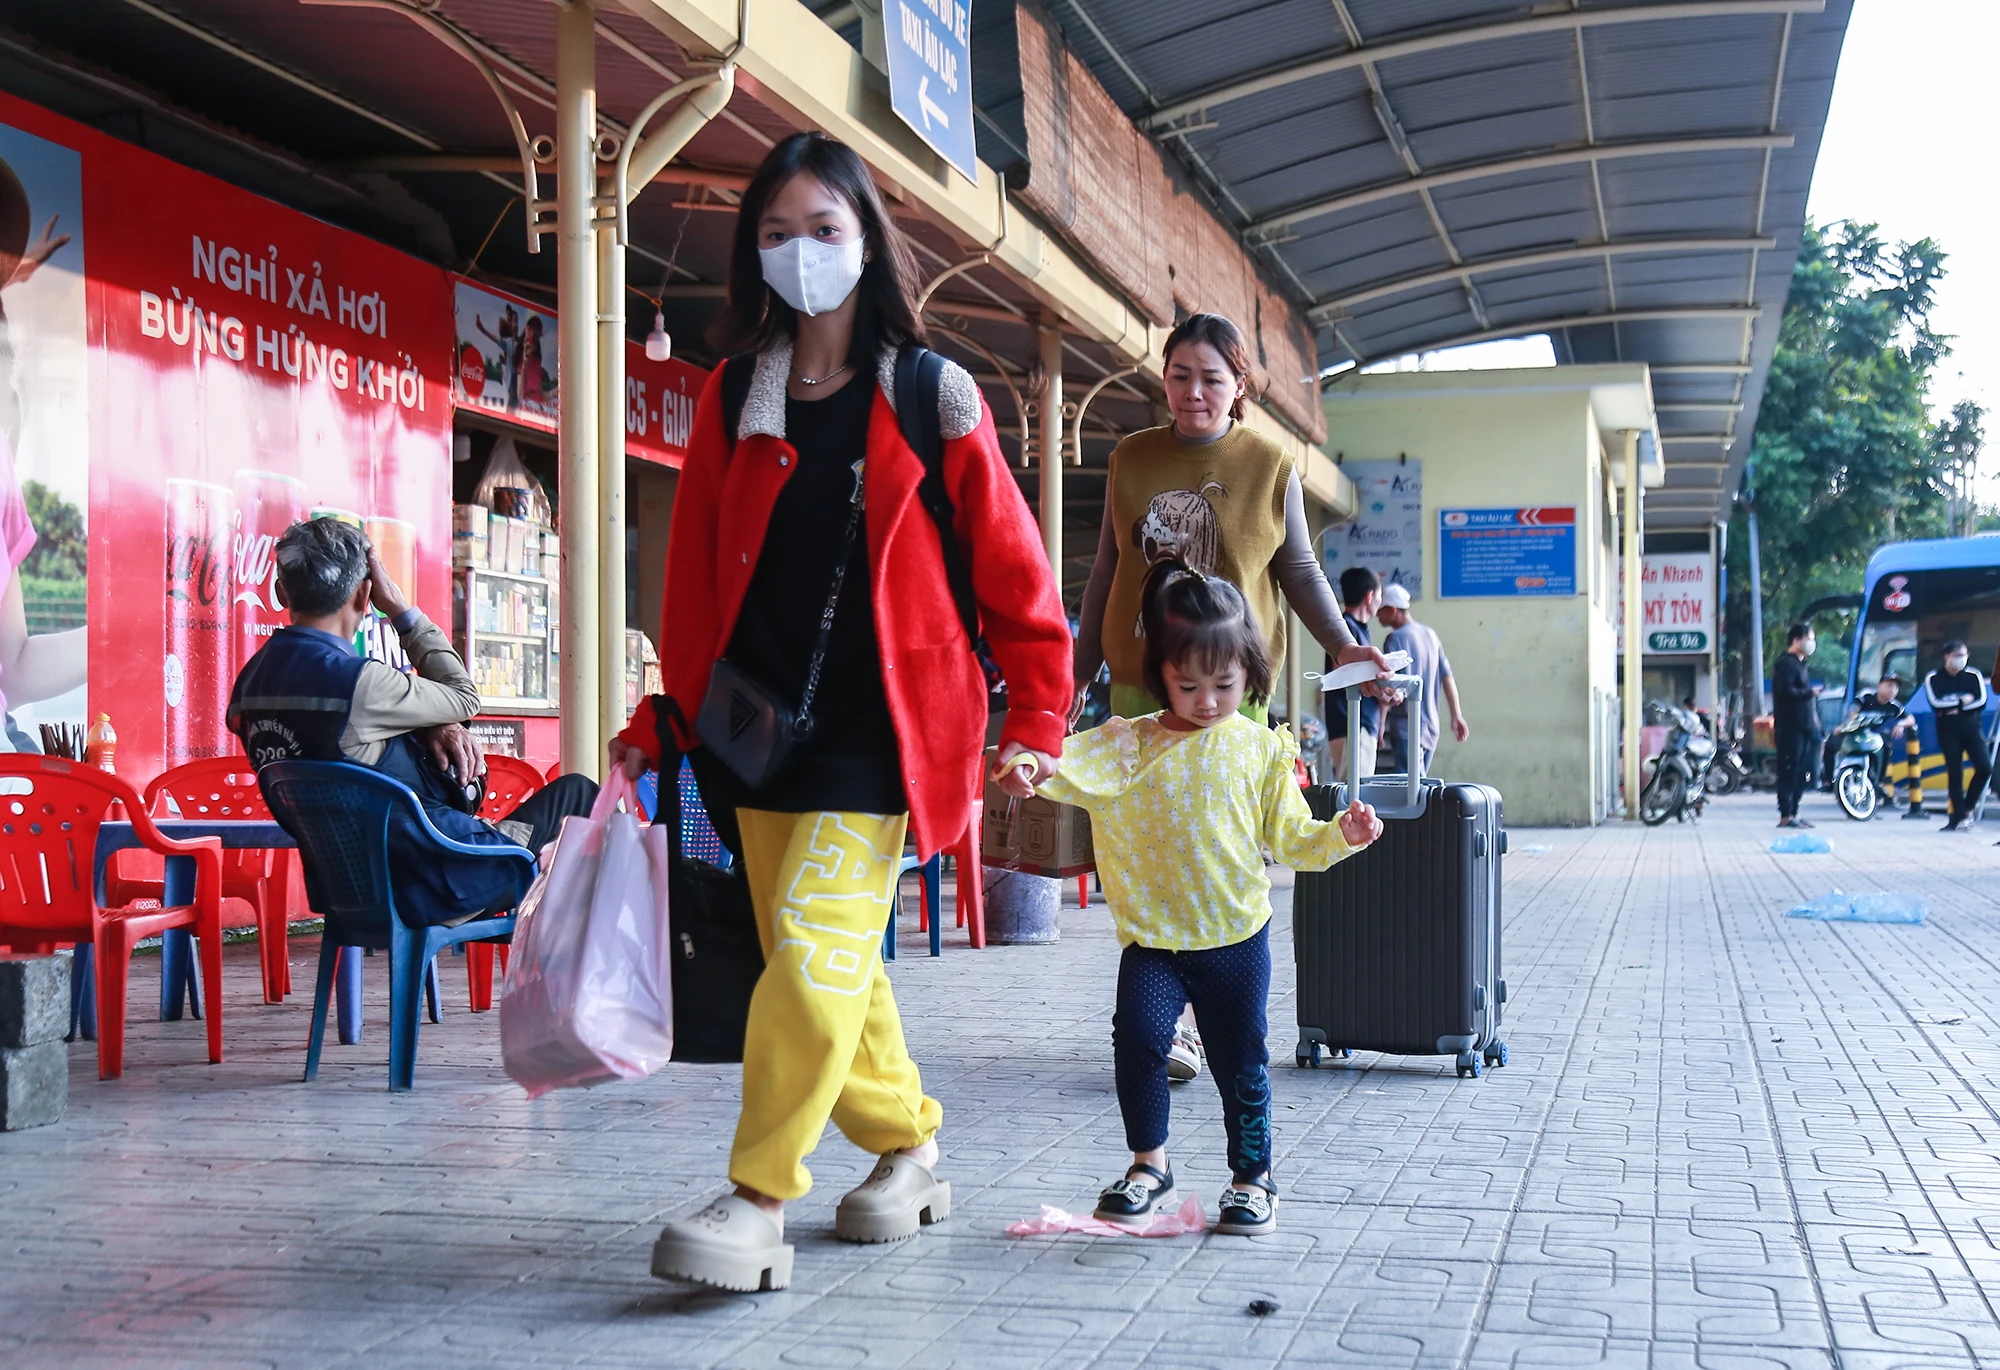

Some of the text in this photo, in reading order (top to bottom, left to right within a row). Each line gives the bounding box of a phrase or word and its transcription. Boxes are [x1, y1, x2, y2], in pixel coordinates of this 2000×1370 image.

[900, 1, 923, 58] TAXI
[925, 18, 938, 73] ÂU
[940, 41, 958, 95] LẠC
[955, 1, 966, 47] XE
[192, 234, 387, 339] NGHỈ XẢ HƠI
[140, 285, 425, 412] BỪNG HỨNG KHỞI
[626, 375, 647, 437] C5
[1663, 565, 1703, 582] Nhanh
[243, 621, 252, 638] VỊ
[776, 812, 894, 997] AP
